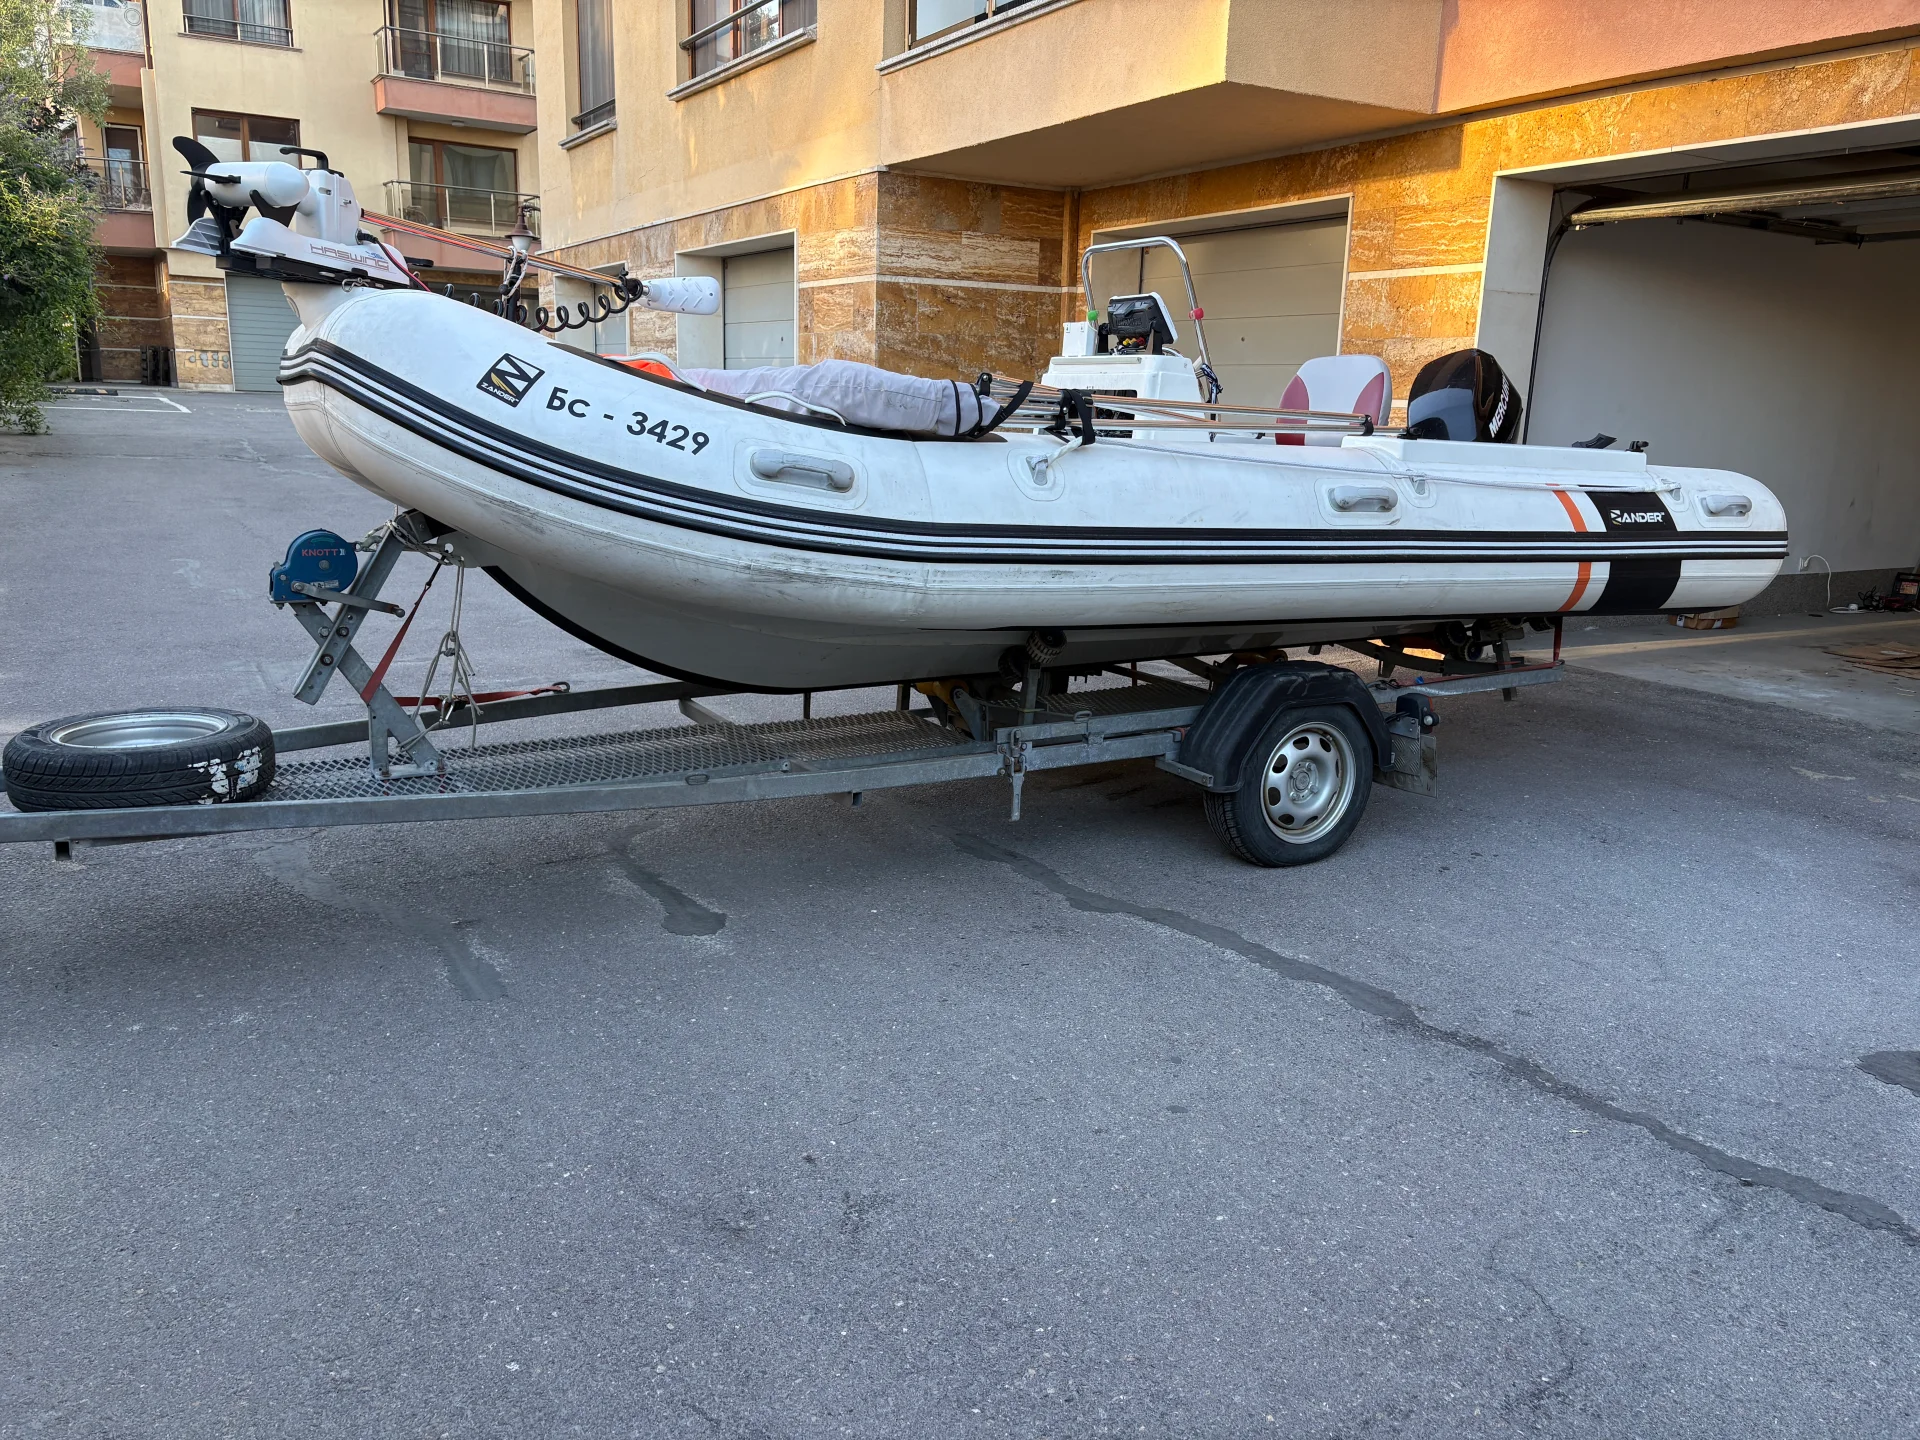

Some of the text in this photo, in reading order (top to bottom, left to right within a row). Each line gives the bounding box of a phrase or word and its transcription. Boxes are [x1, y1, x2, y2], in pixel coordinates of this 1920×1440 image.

[310, 244, 389, 272] HASWING
[626, 411, 710, 456] 3429
[301, 548, 339, 557] KNOTT
